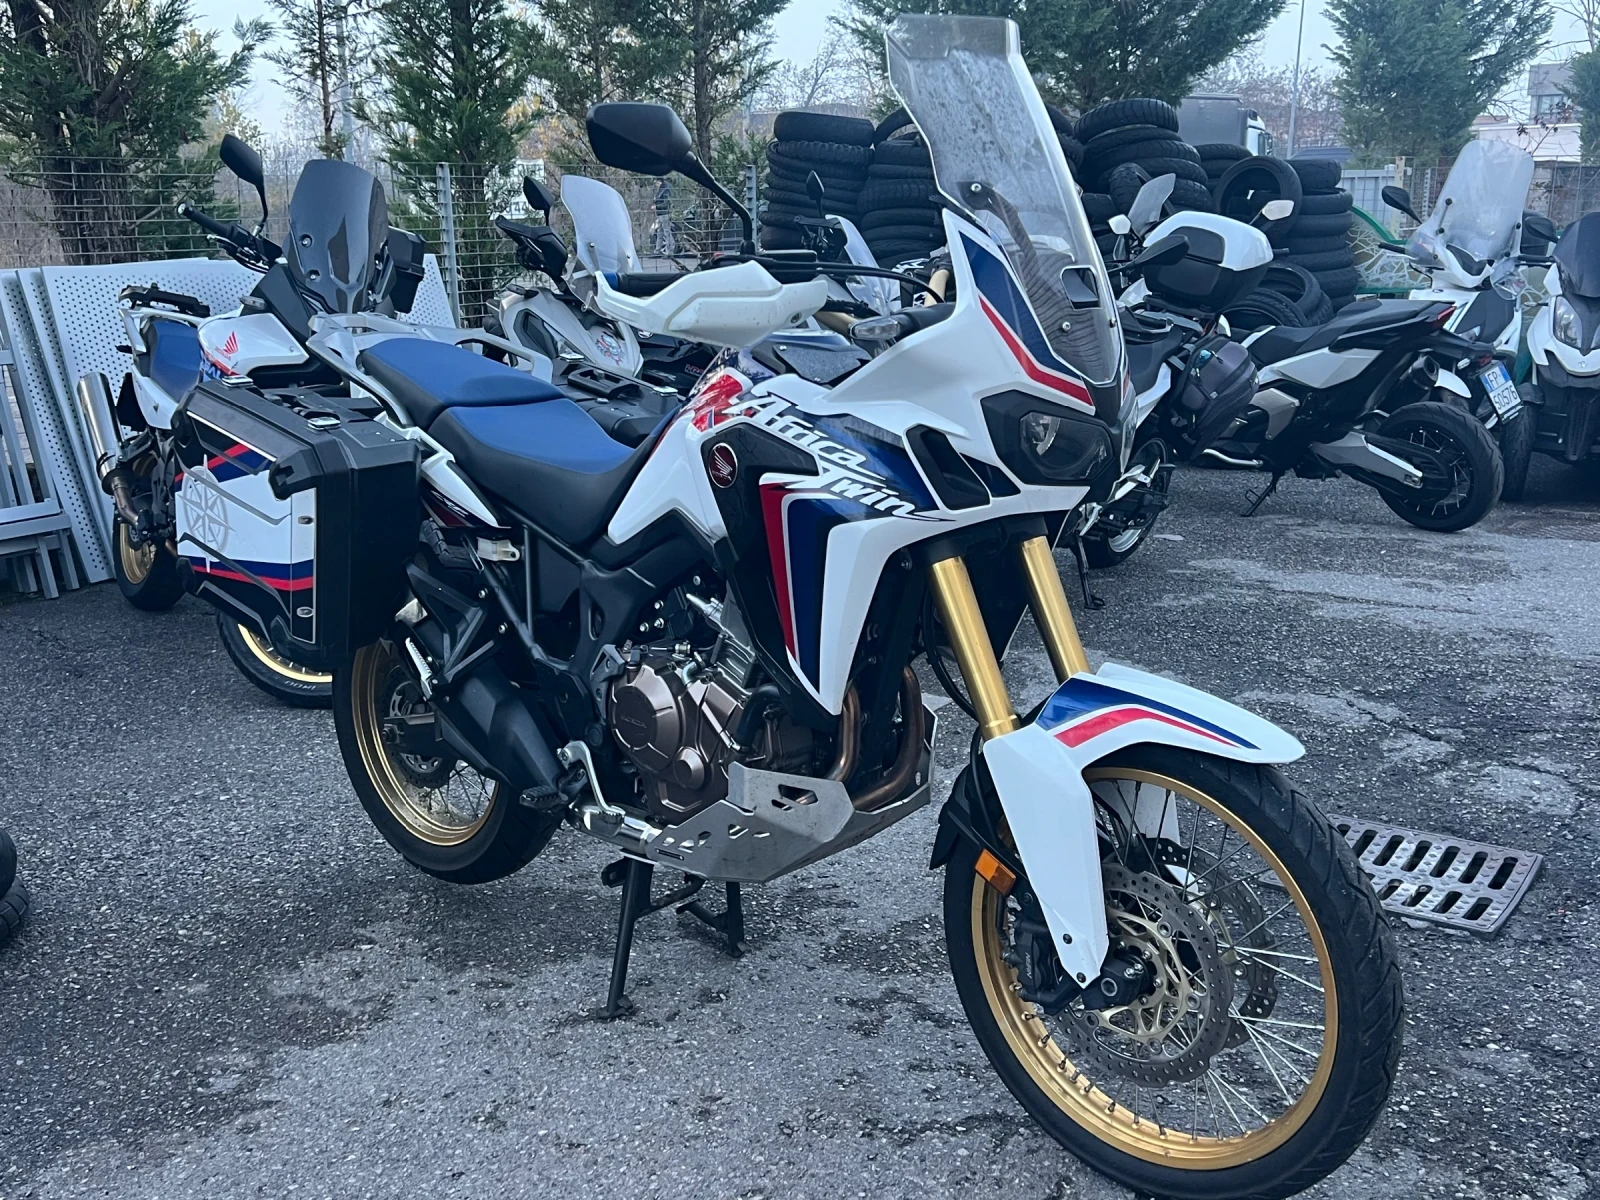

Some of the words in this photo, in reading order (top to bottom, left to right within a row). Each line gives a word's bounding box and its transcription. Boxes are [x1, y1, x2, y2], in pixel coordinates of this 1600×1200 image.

[1487, 371, 1500, 388] FP
[1493, 385, 1518, 410] 50576
[722, 394, 886, 481] Africa
[785, 457, 940, 521] Twin
